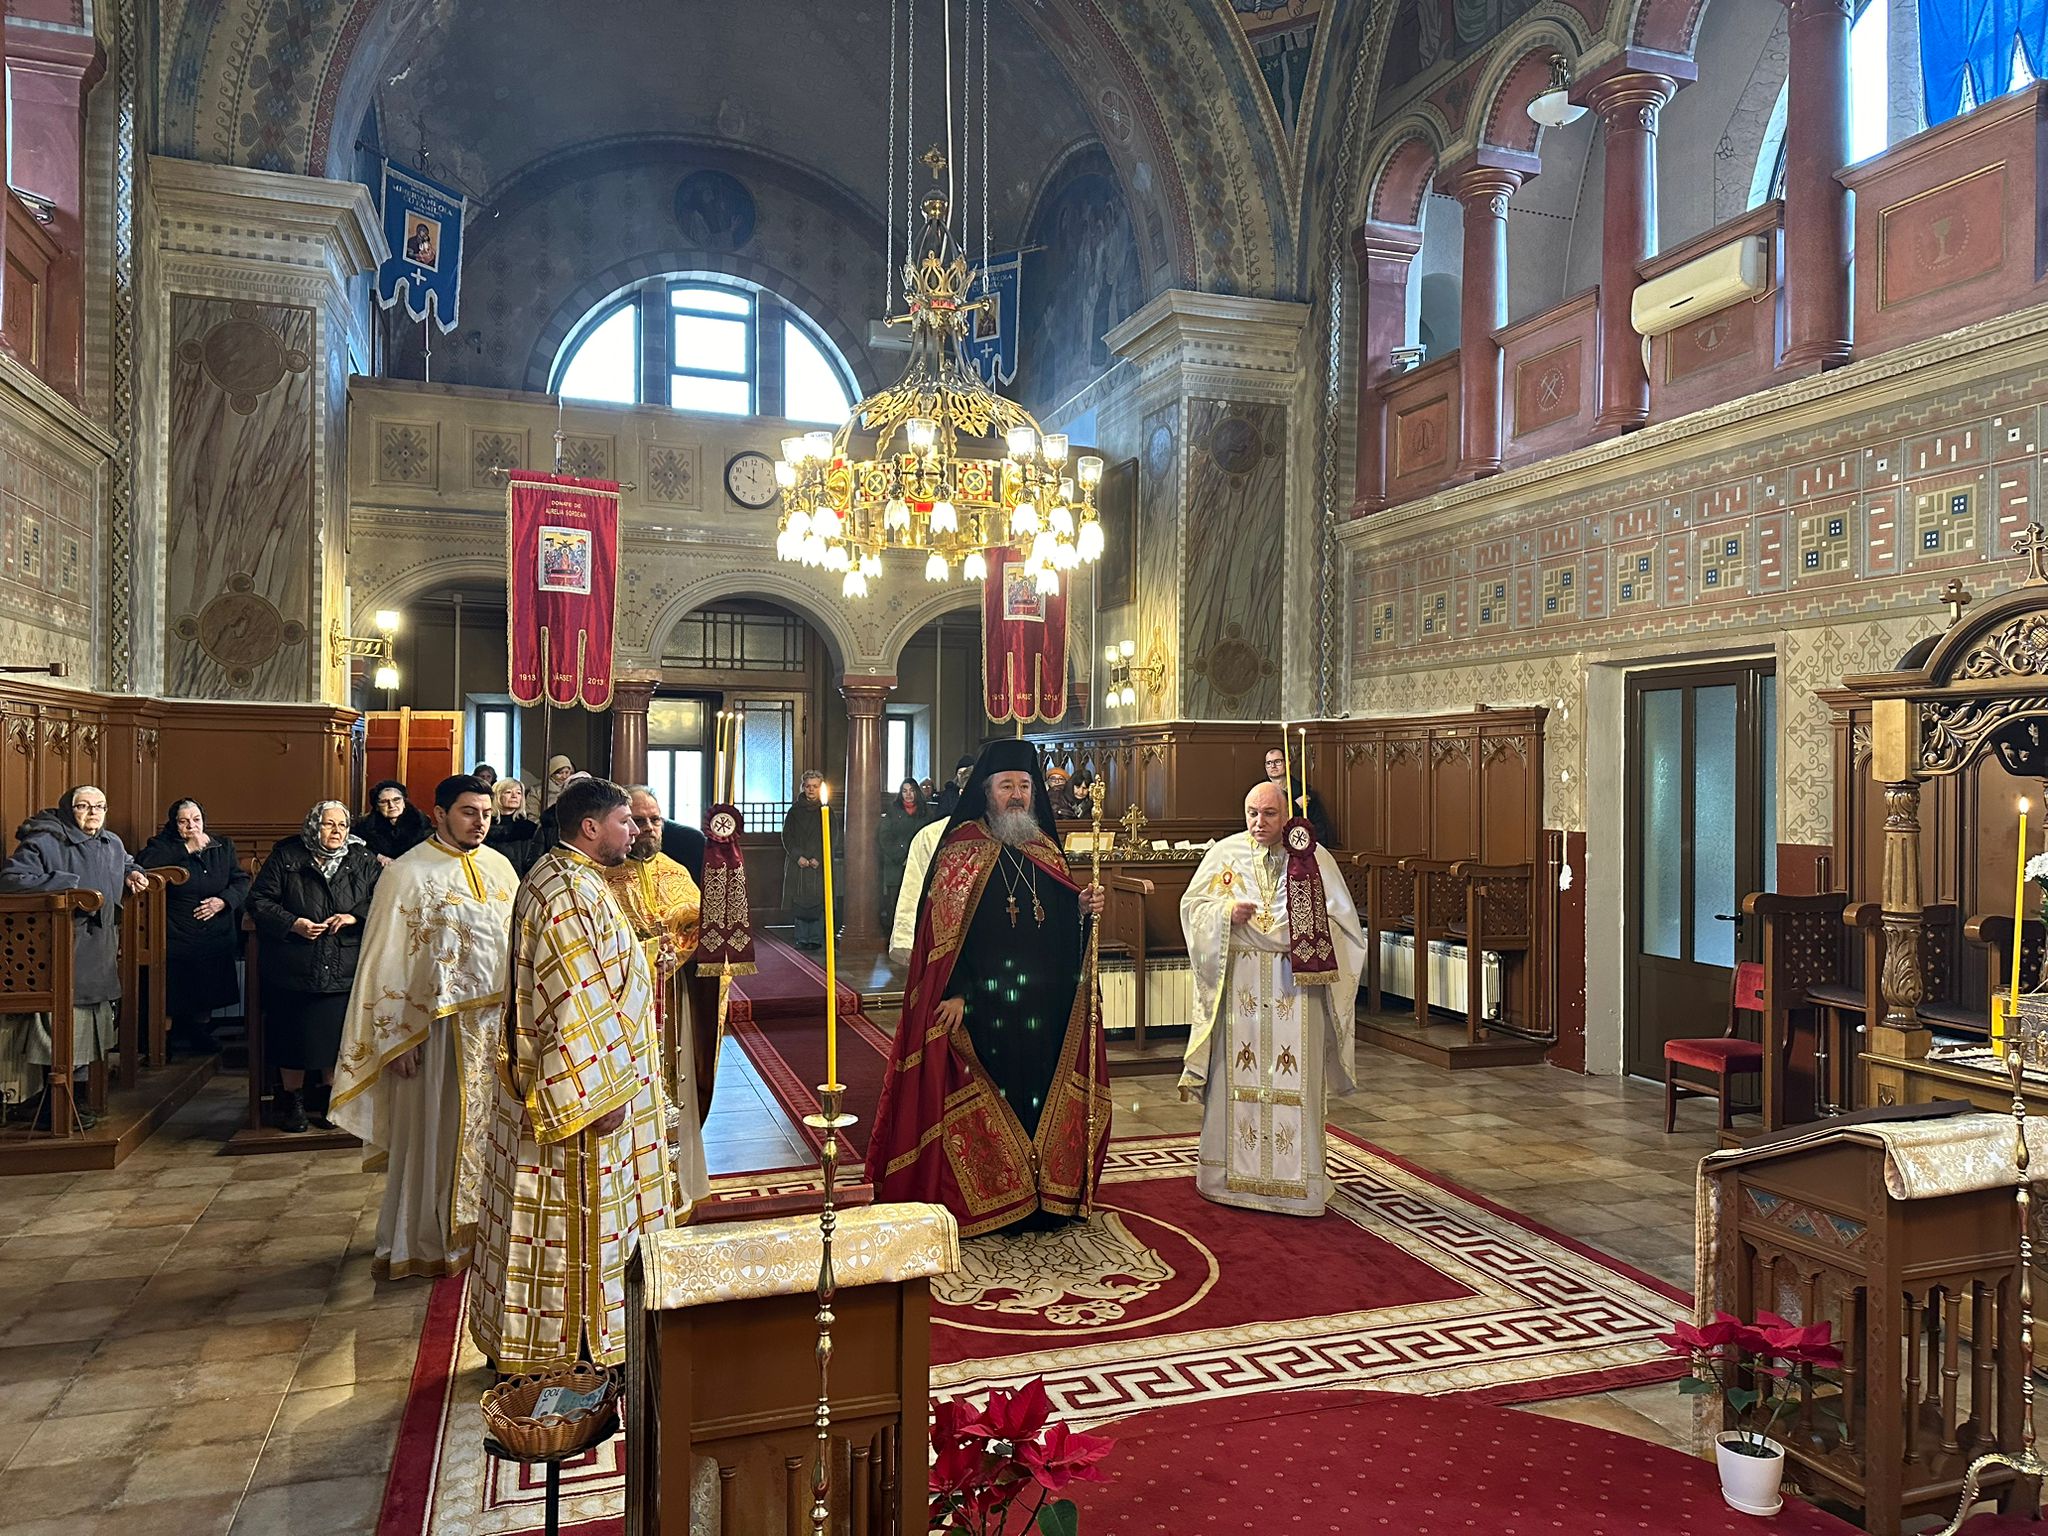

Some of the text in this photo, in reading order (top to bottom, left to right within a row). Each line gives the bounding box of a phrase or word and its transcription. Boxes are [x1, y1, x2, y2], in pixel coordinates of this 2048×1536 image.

[519, 673, 536, 681] 1913
[587, 677, 604, 685] 2013
[544, 1388, 560, 1398] 100
